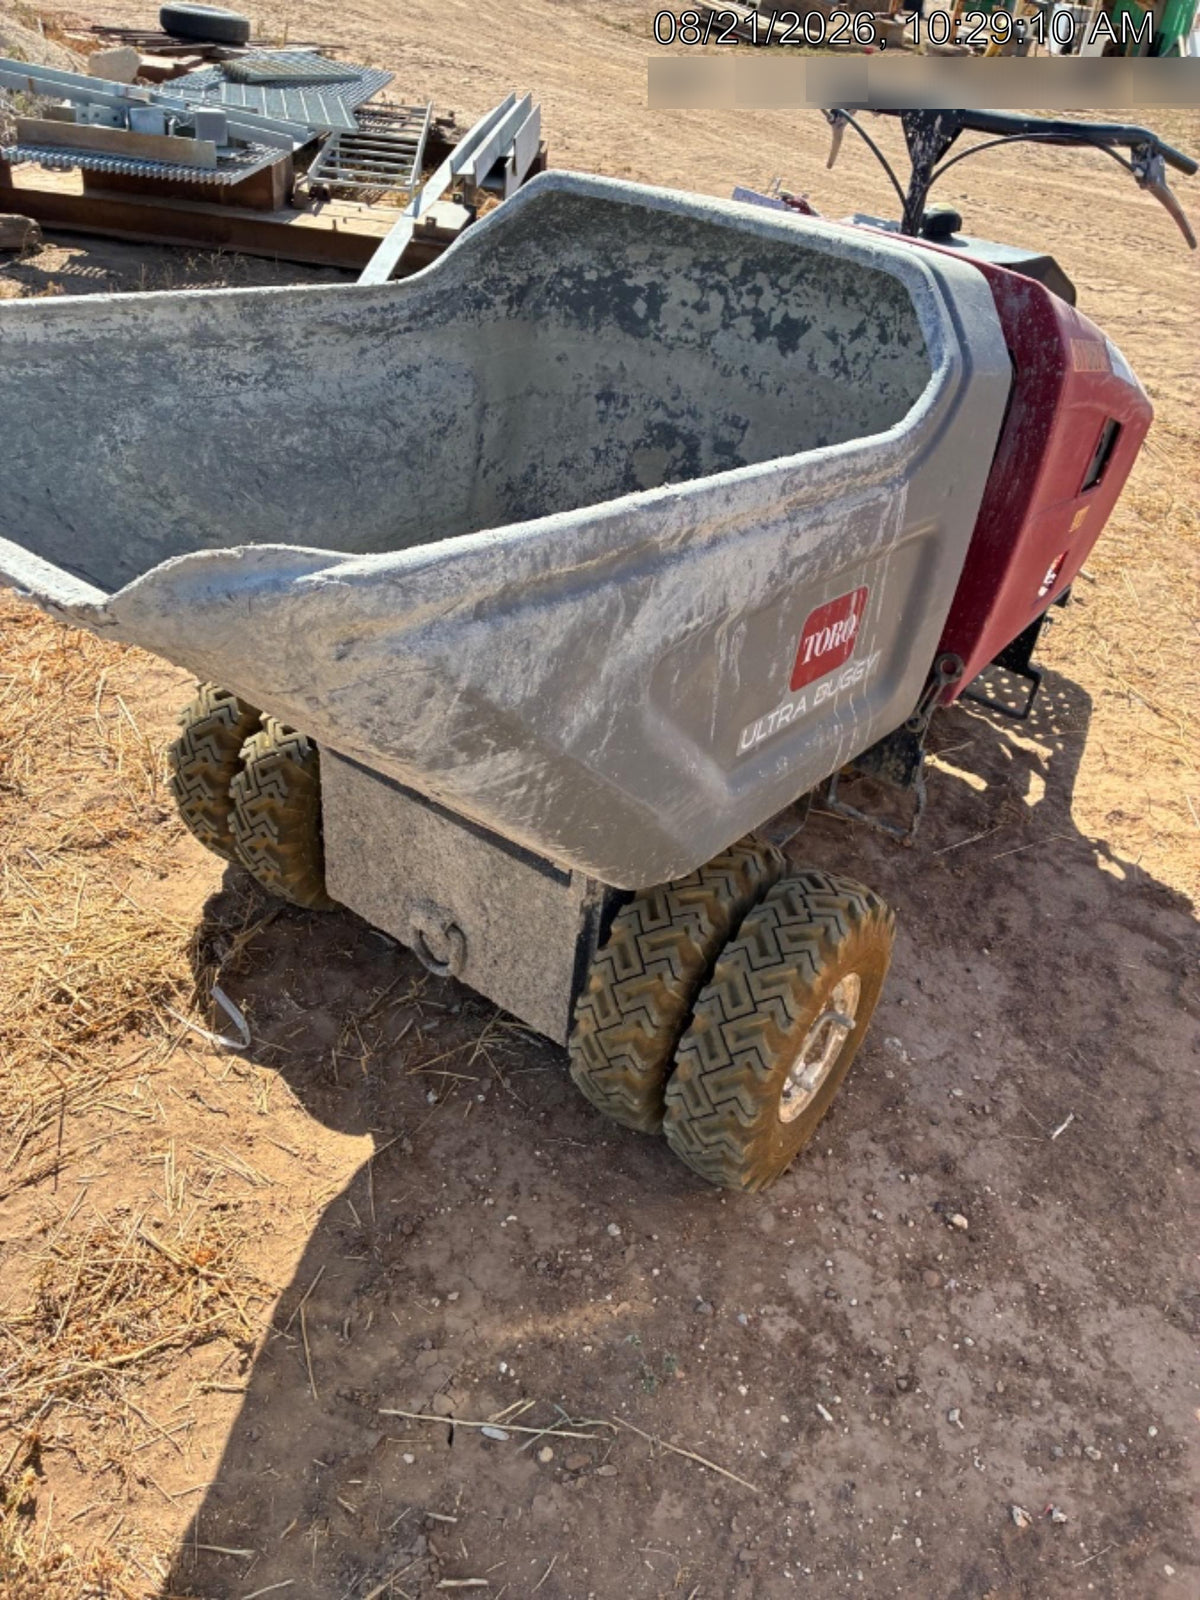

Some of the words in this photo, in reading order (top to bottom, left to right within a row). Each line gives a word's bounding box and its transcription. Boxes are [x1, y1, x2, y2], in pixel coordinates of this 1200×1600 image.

[801, 614, 858, 666] TORO
[740, 694, 807, 750] ULTRA
[813, 650, 881, 706] BUGGY
